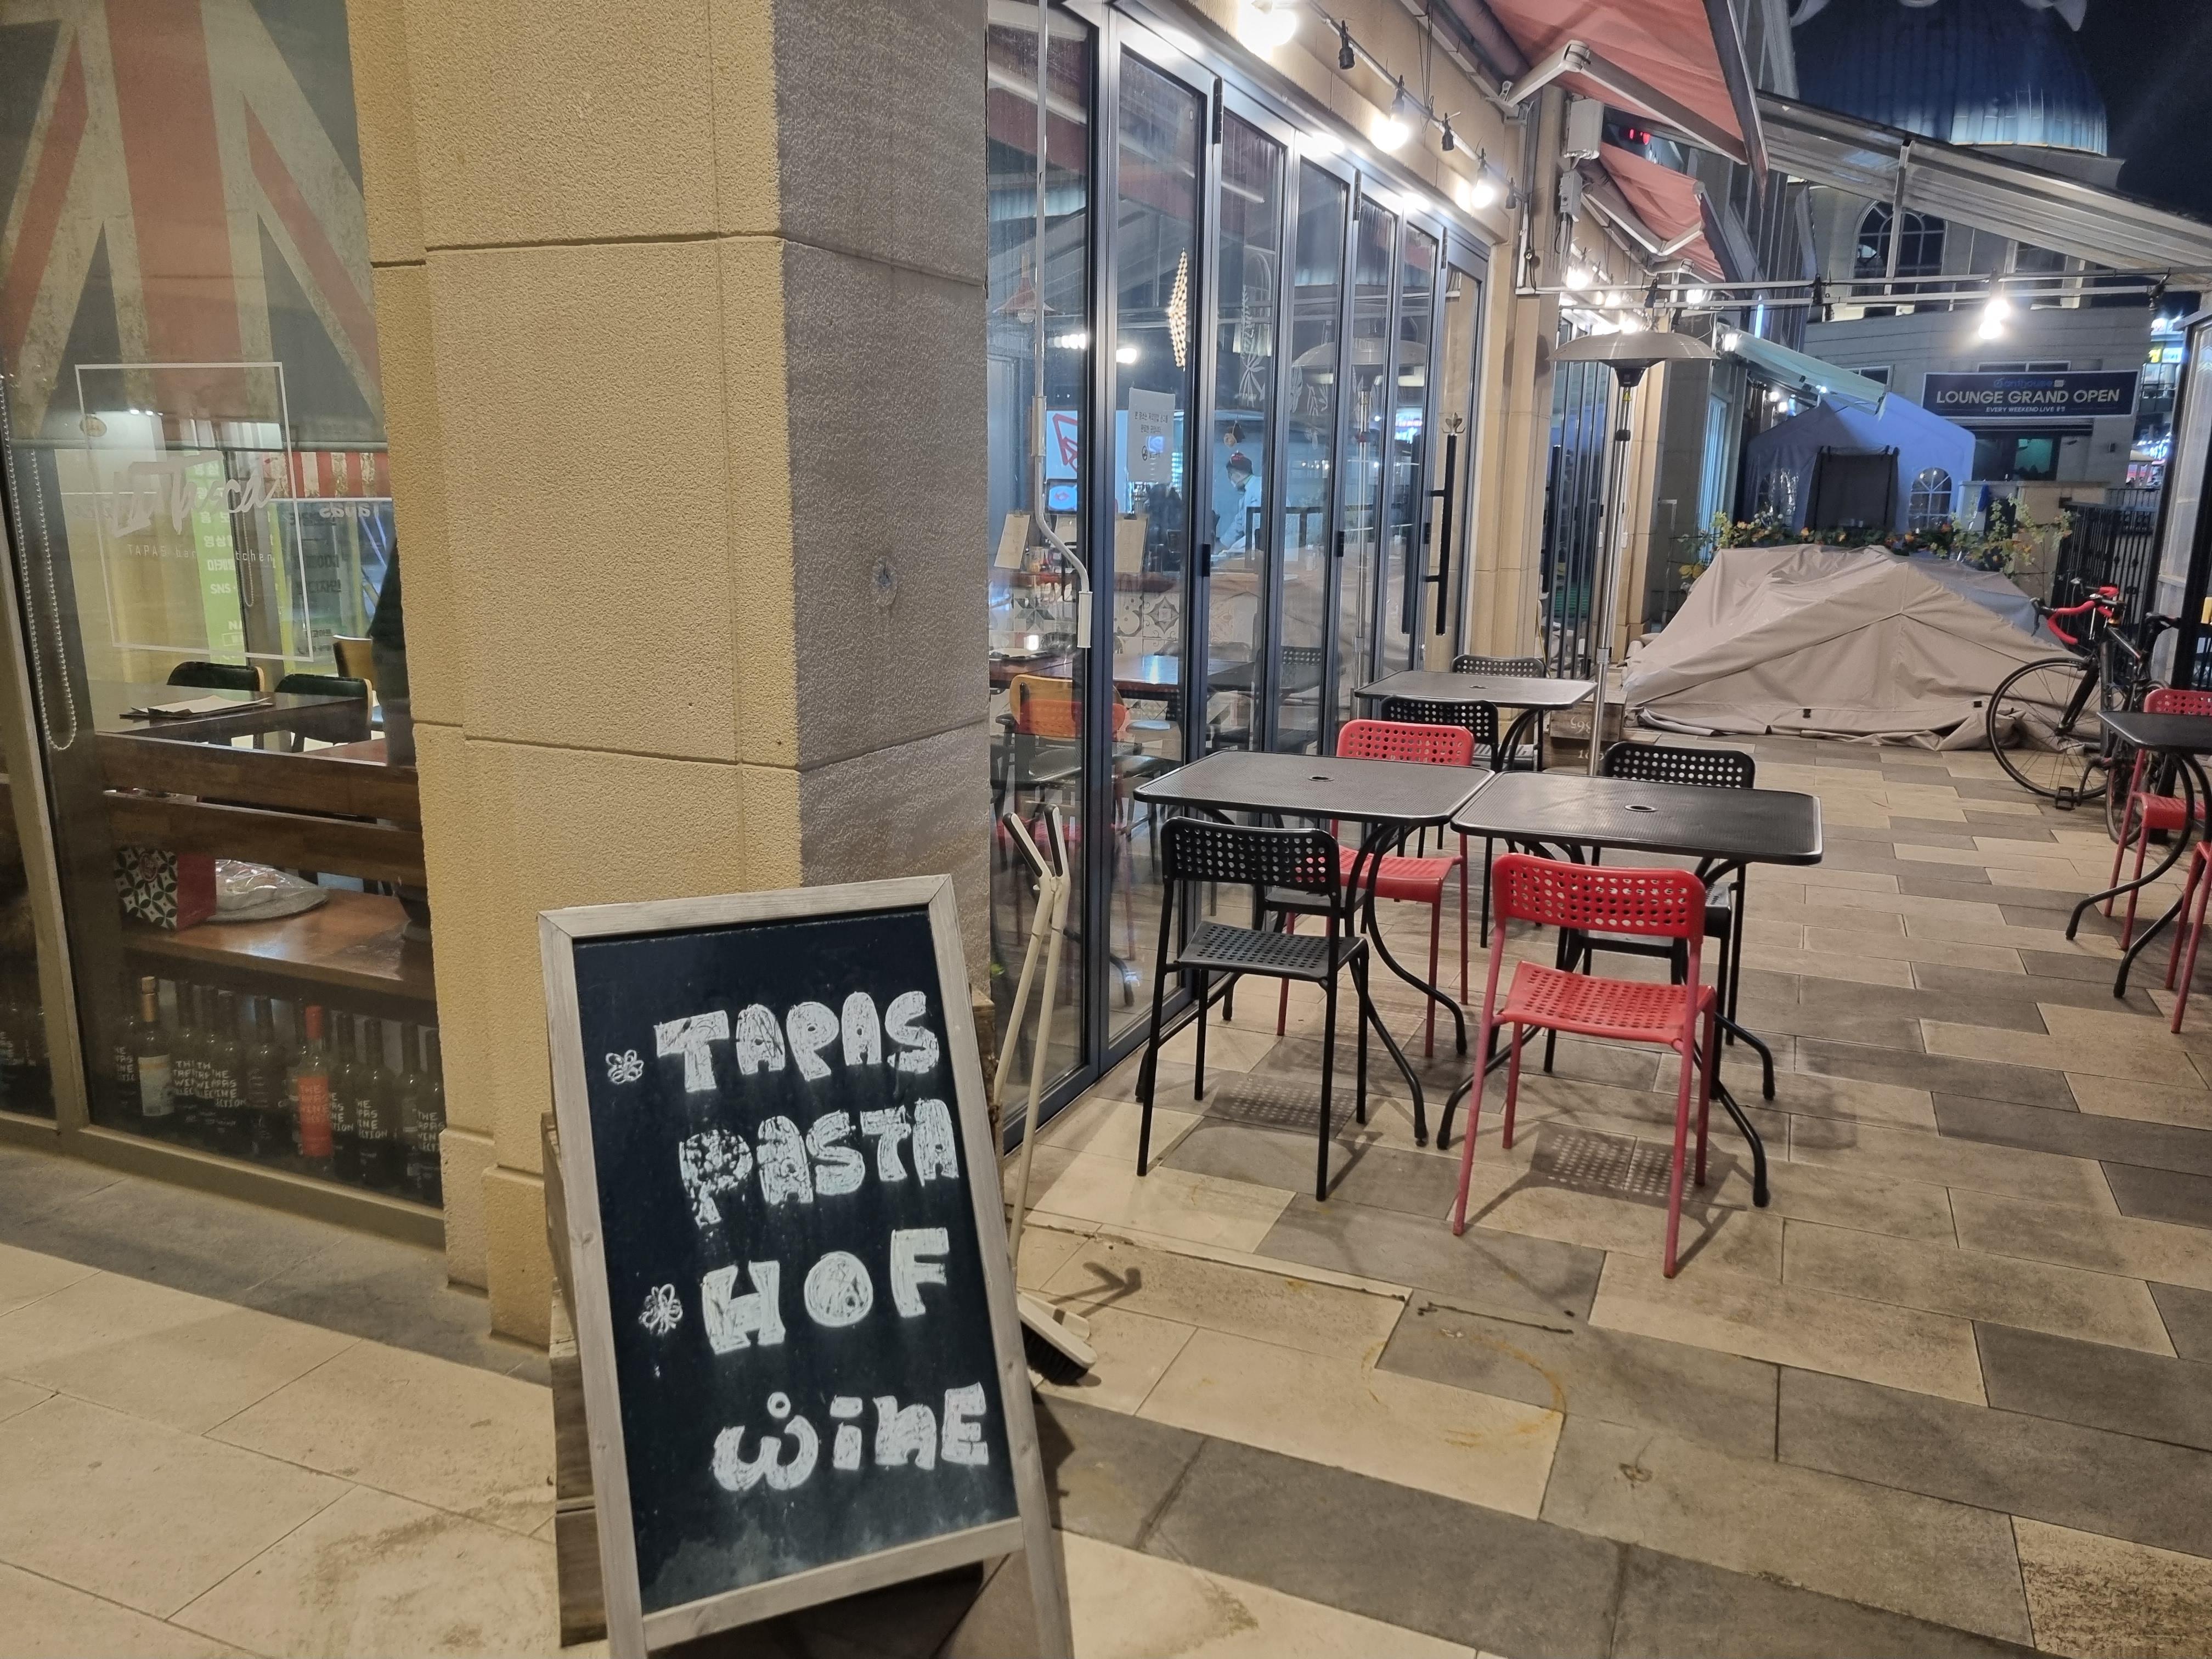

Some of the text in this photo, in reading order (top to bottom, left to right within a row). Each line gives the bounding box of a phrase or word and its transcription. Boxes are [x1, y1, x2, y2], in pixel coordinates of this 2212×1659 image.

[1936, 388, 2120, 405] LOUNGE GRAND OPEN
[127, 544, 167, 557] TAPAS
[654, 991, 940, 1093] TAPAS
[679, 1098, 960, 1229] PASTA
[701, 1227, 950, 1355] HOF
